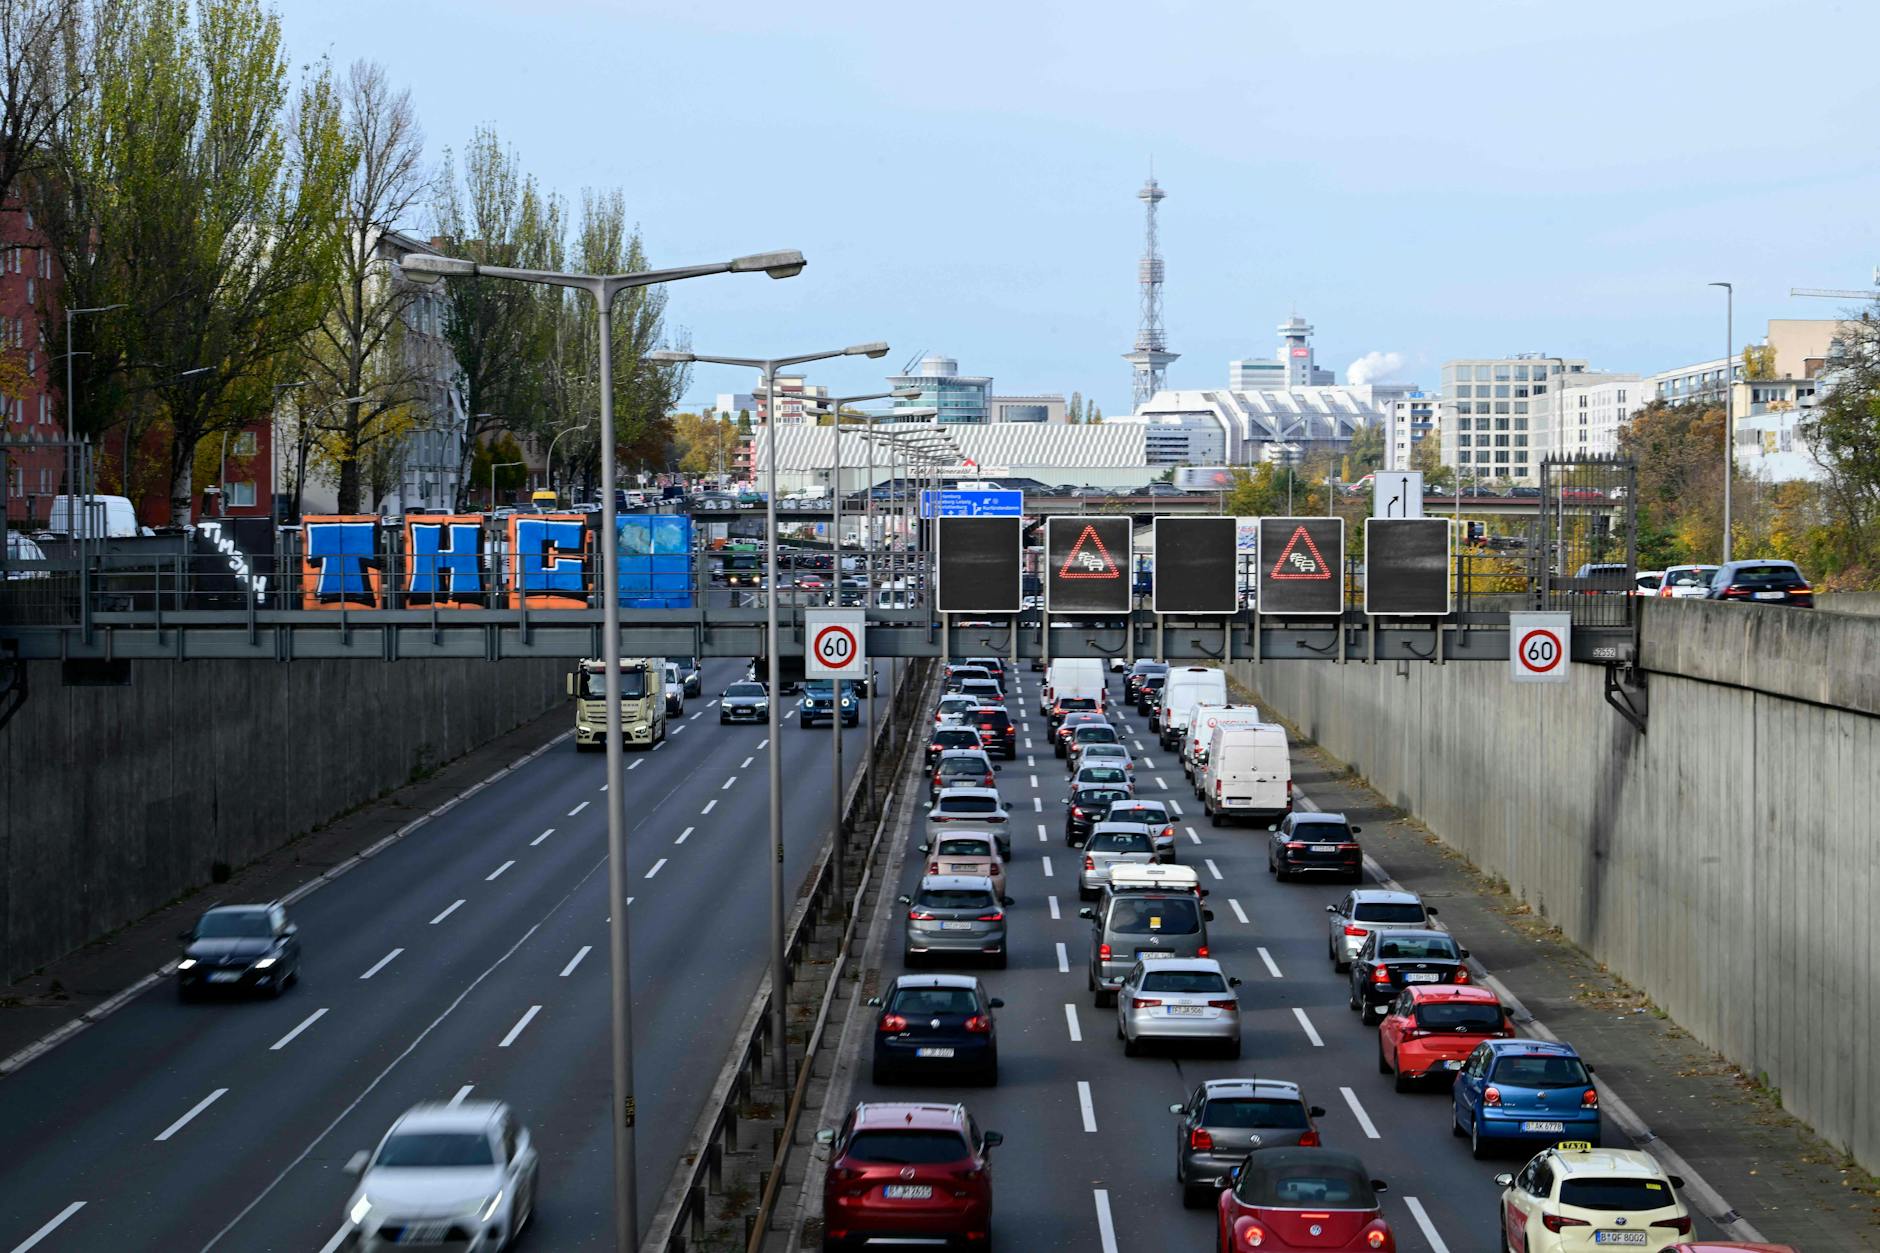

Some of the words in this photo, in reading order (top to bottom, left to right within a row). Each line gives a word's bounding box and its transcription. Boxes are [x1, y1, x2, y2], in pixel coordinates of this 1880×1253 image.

[823, 637, 848, 657] 60
[1528, 641, 1553, 661] 60
[1562, 1142, 1587, 1150] TAXI
[1601, 1232, 1607, 1241] B
